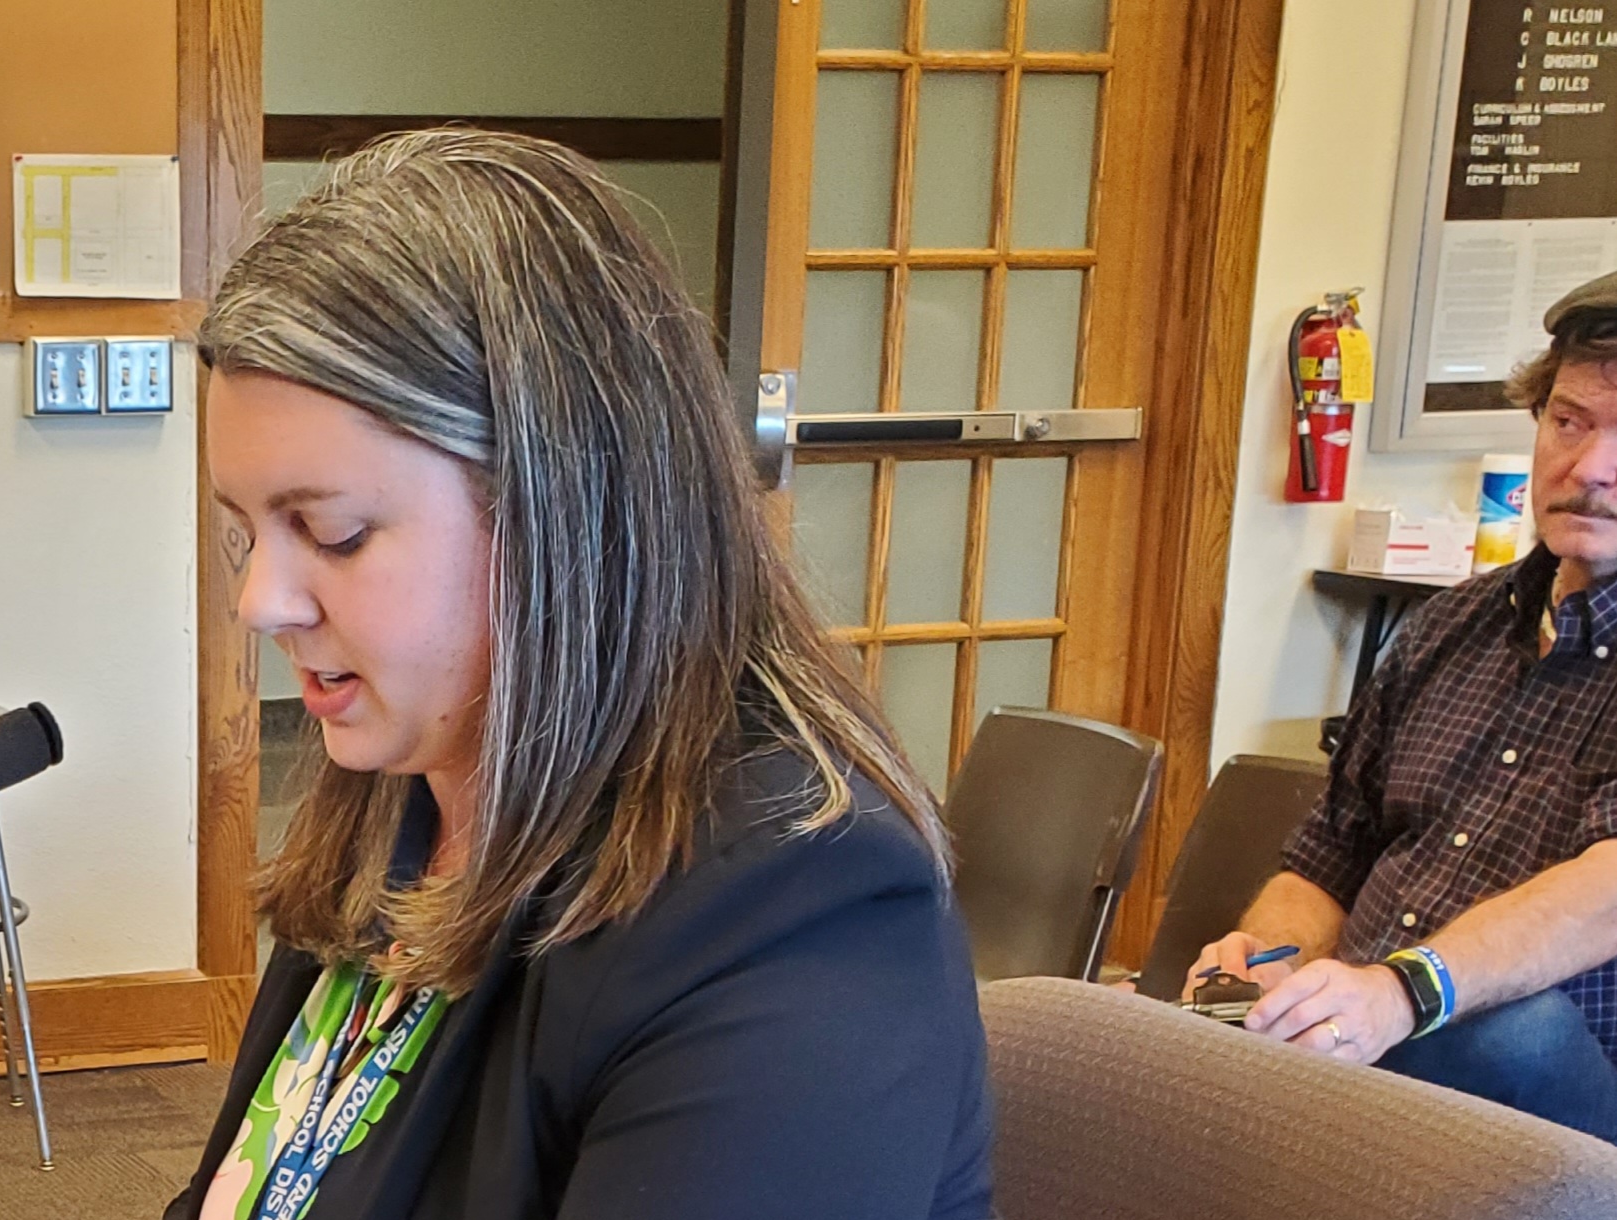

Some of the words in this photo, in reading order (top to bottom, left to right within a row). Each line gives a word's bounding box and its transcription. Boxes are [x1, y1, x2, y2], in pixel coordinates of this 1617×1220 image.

[1523, 8, 1533, 22] R
[1548, 8, 1603, 23] NELSON
[1546, 31, 1590, 46] BLACK
[1517, 53, 1527, 69] J
[1539, 76, 1590, 92] BOYLES
[312, 1076, 378, 1171] SCHOOL
